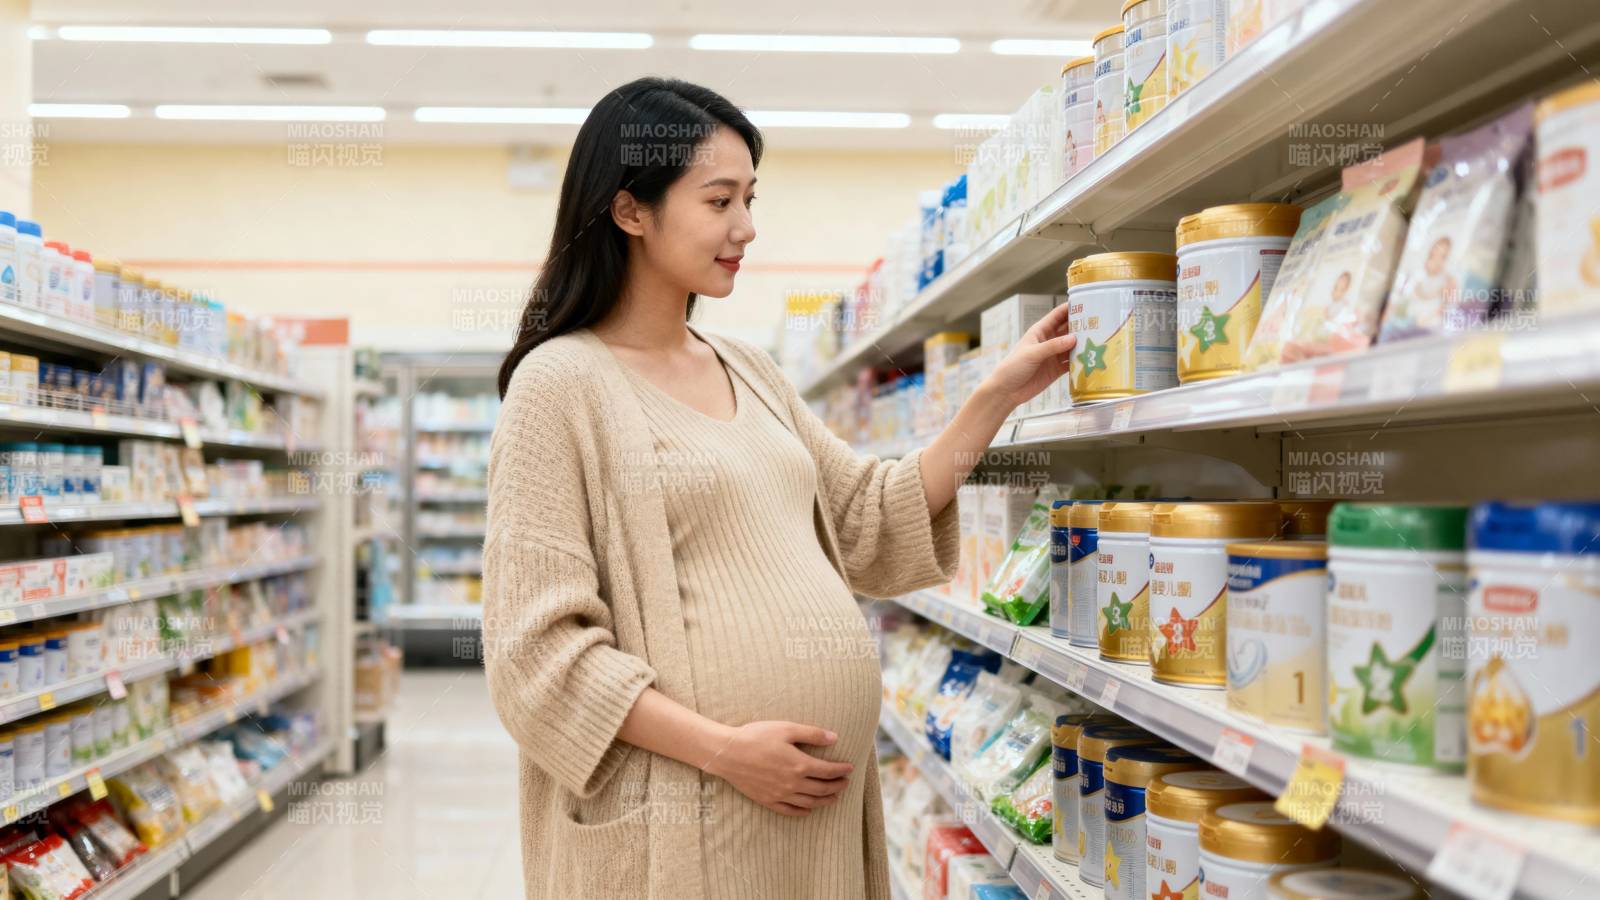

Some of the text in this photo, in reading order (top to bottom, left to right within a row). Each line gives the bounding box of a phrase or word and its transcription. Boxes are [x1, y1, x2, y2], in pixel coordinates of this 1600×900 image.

[1087, 350, 1098, 368] 3
[1112, 606, 1121, 625] 3
[1293, 671, 1305, 704] 1
[1571, 717, 1587, 758] 1
